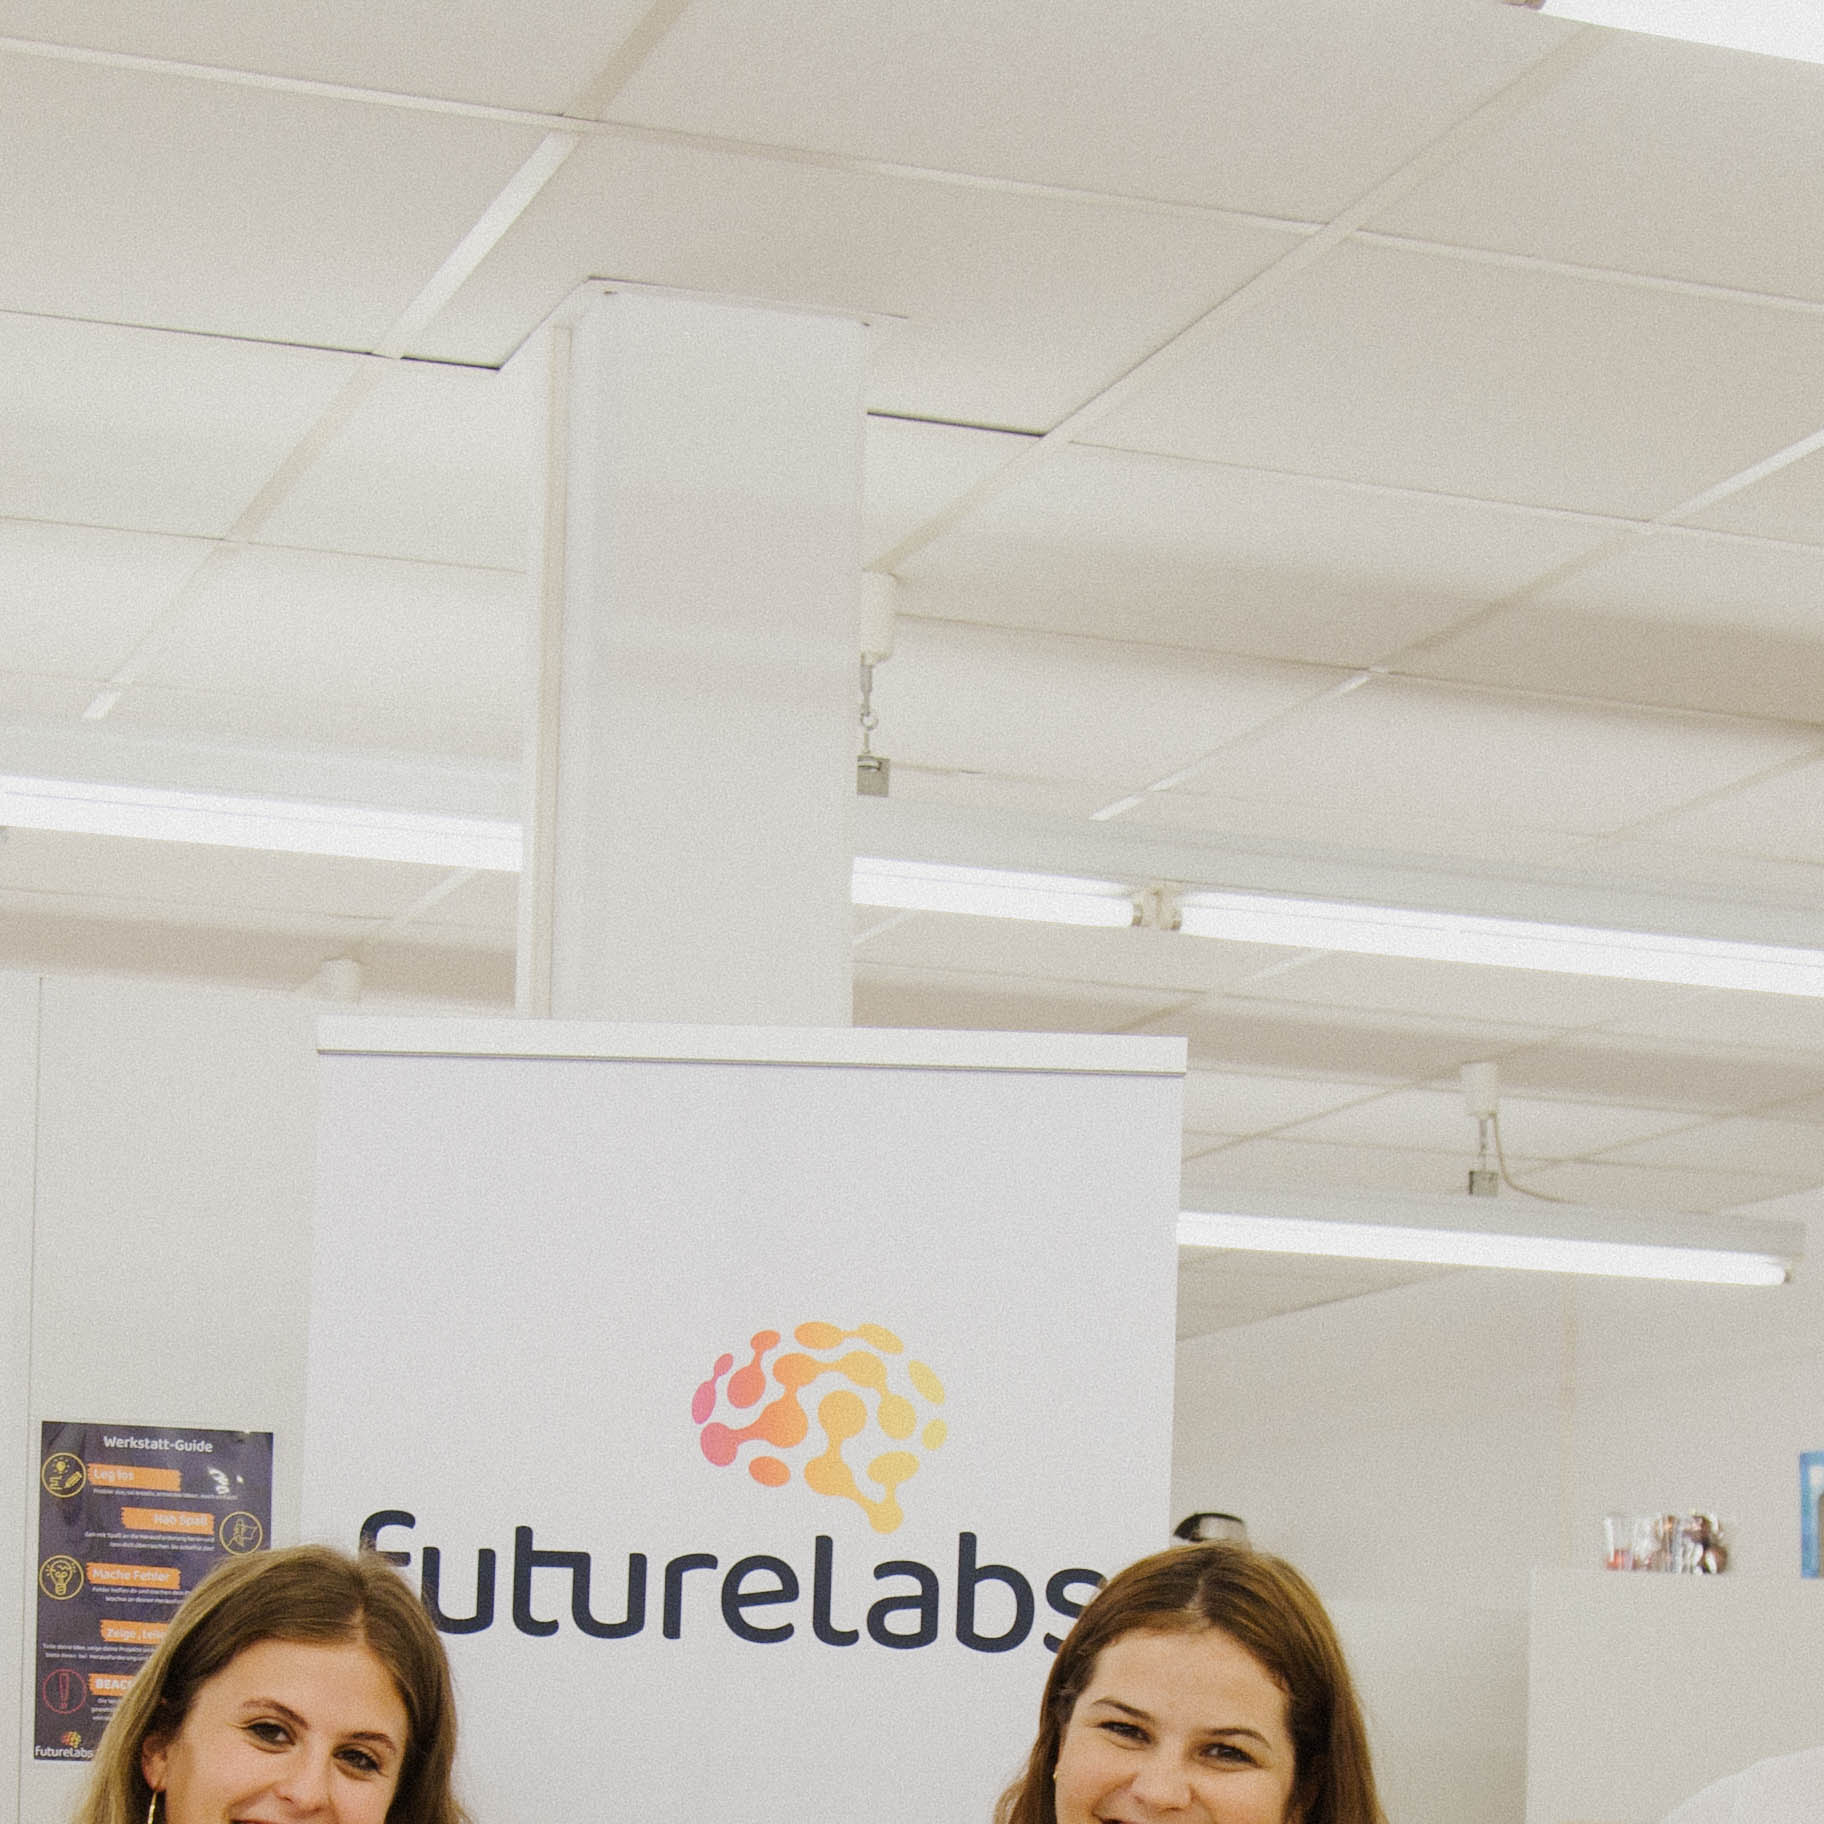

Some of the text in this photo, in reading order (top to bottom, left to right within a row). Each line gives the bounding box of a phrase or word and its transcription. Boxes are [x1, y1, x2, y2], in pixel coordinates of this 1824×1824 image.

[103, 1435, 214, 1453] Werkstatt-Guide
[153, 1513, 176, 1526] Hab
[92, 1568, 170, 1582] Mache Fehler
[95, 1678, 132, 1690] BEAC
